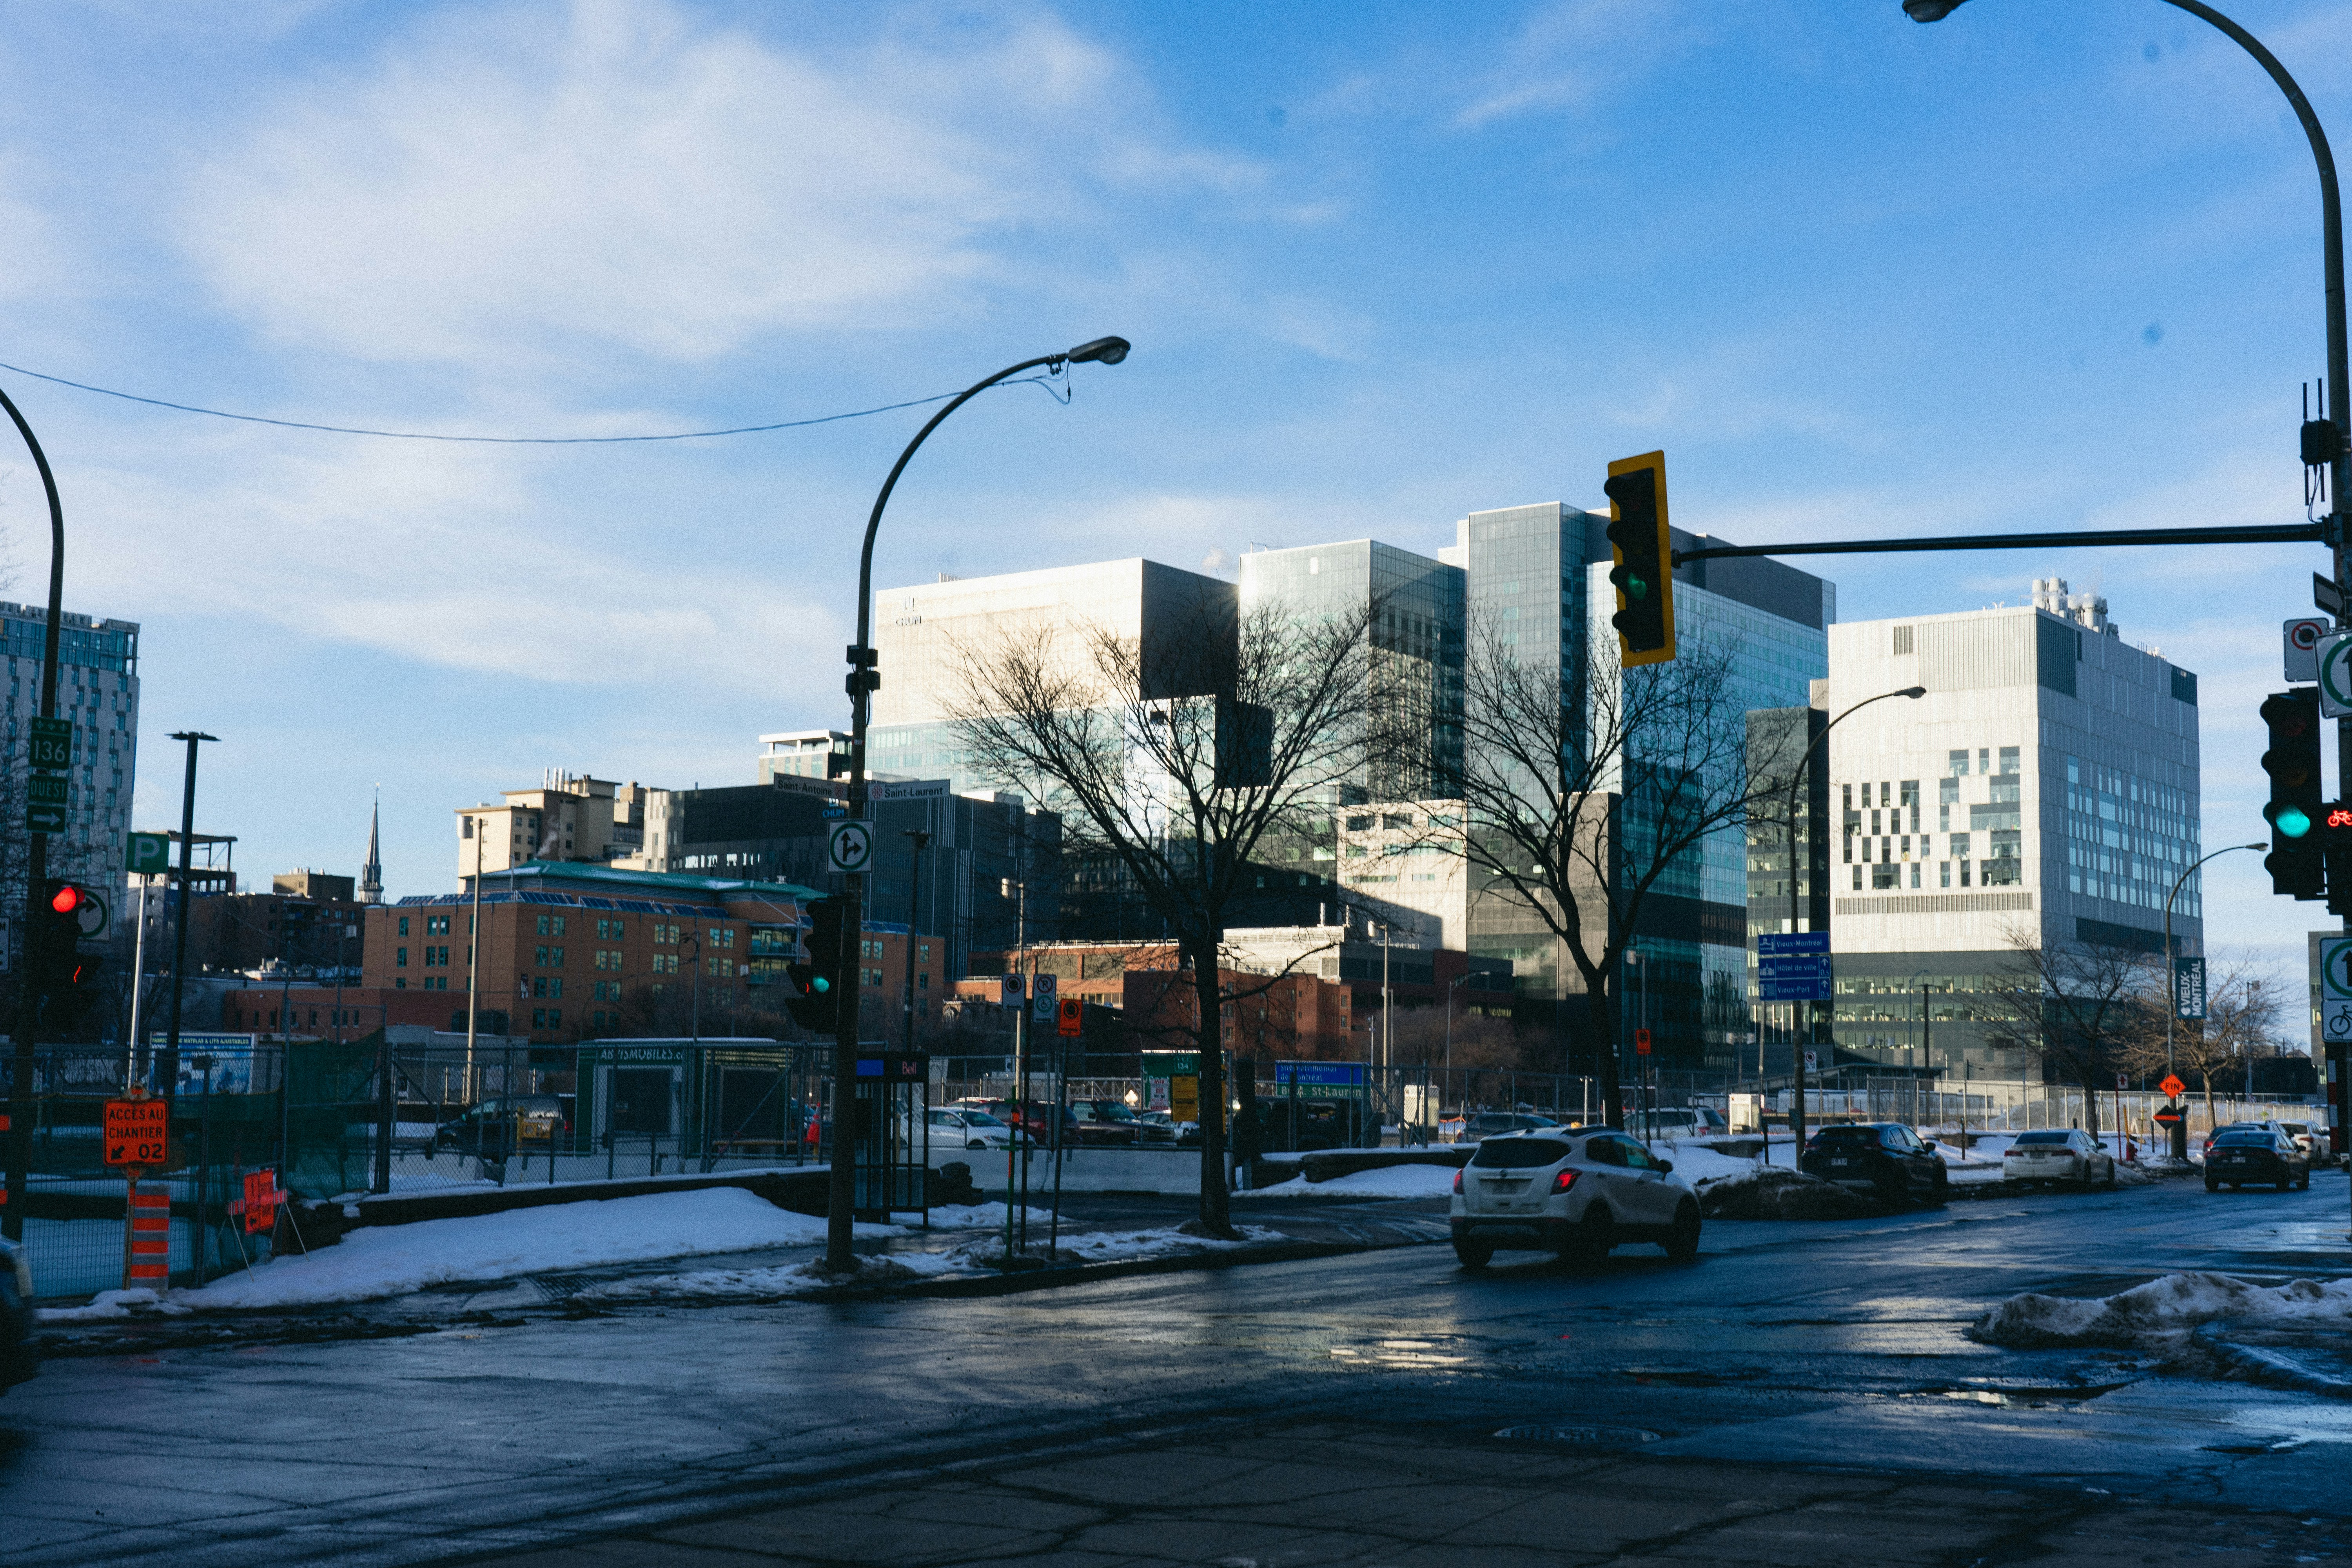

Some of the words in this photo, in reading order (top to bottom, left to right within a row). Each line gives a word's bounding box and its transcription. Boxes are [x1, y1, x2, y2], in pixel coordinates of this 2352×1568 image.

[34, 740, 65, 762] 136
[31, 780, 65, 798] OUEST
[778, 779, 832, 796] Saint-Antoine
[884, 787, 943, 798] Saint-Laurent
[822, 808, 845, 818] CHUM
[134, 837, 160, 867] P
[1776, 939, 1822, 947] Vieux-Montréal
[1777, 985, 1810, 993] Vieux-Port
[2190, 960, 2202, 1016] MONTRÉAL
[902, 1060, 917, 1075] Bell
[109, 1105, 146, 1120] ACCÈS
[149, 1109, 163, 1120] AU
[109, 1127, 162, 1139] CHANTIER
[139, 1143, 162, 1159] 02
